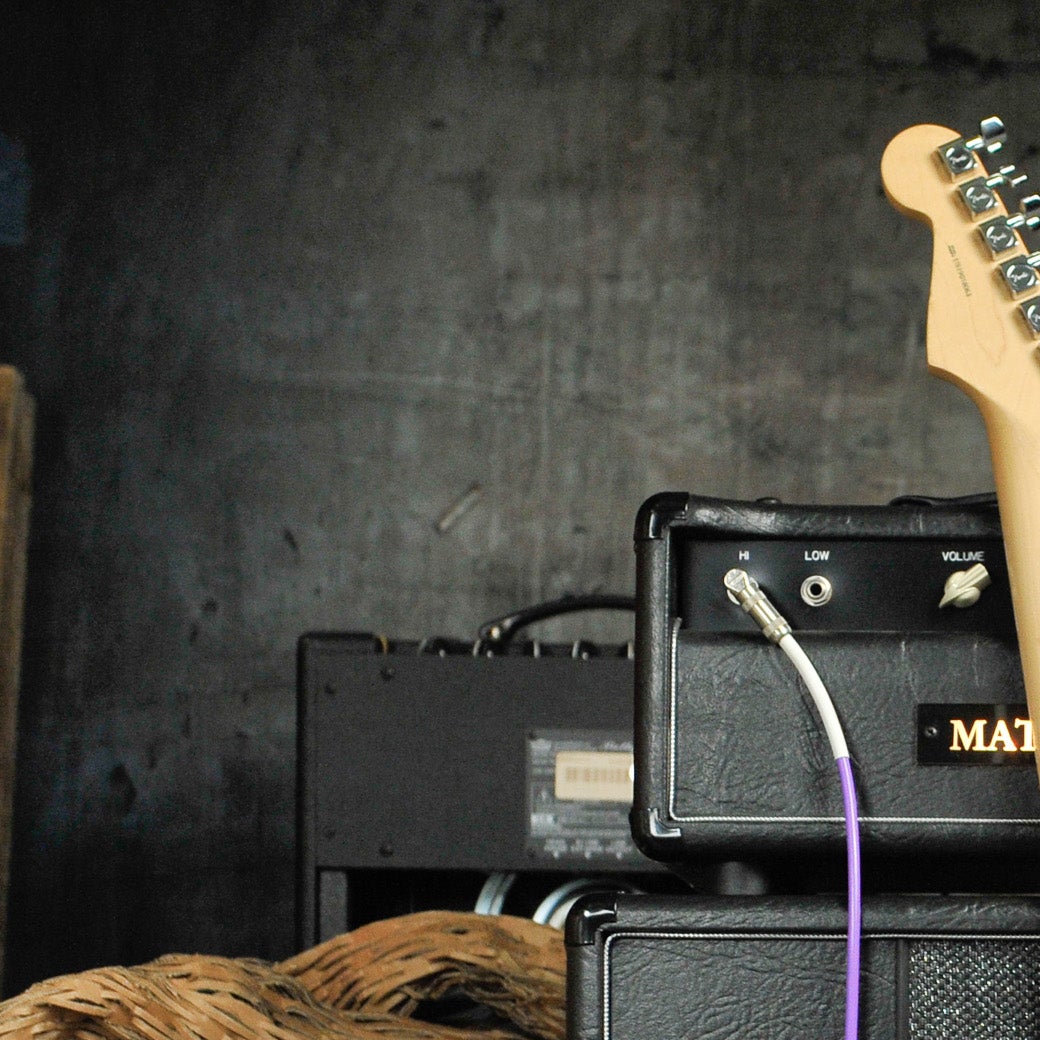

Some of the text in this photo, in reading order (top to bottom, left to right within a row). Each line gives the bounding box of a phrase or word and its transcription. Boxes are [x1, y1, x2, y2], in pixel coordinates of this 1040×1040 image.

[739, 550, 750, 560] HI
[804, 550, 830, 561] LOW
[941, 550, 985, 562] VOLUME
